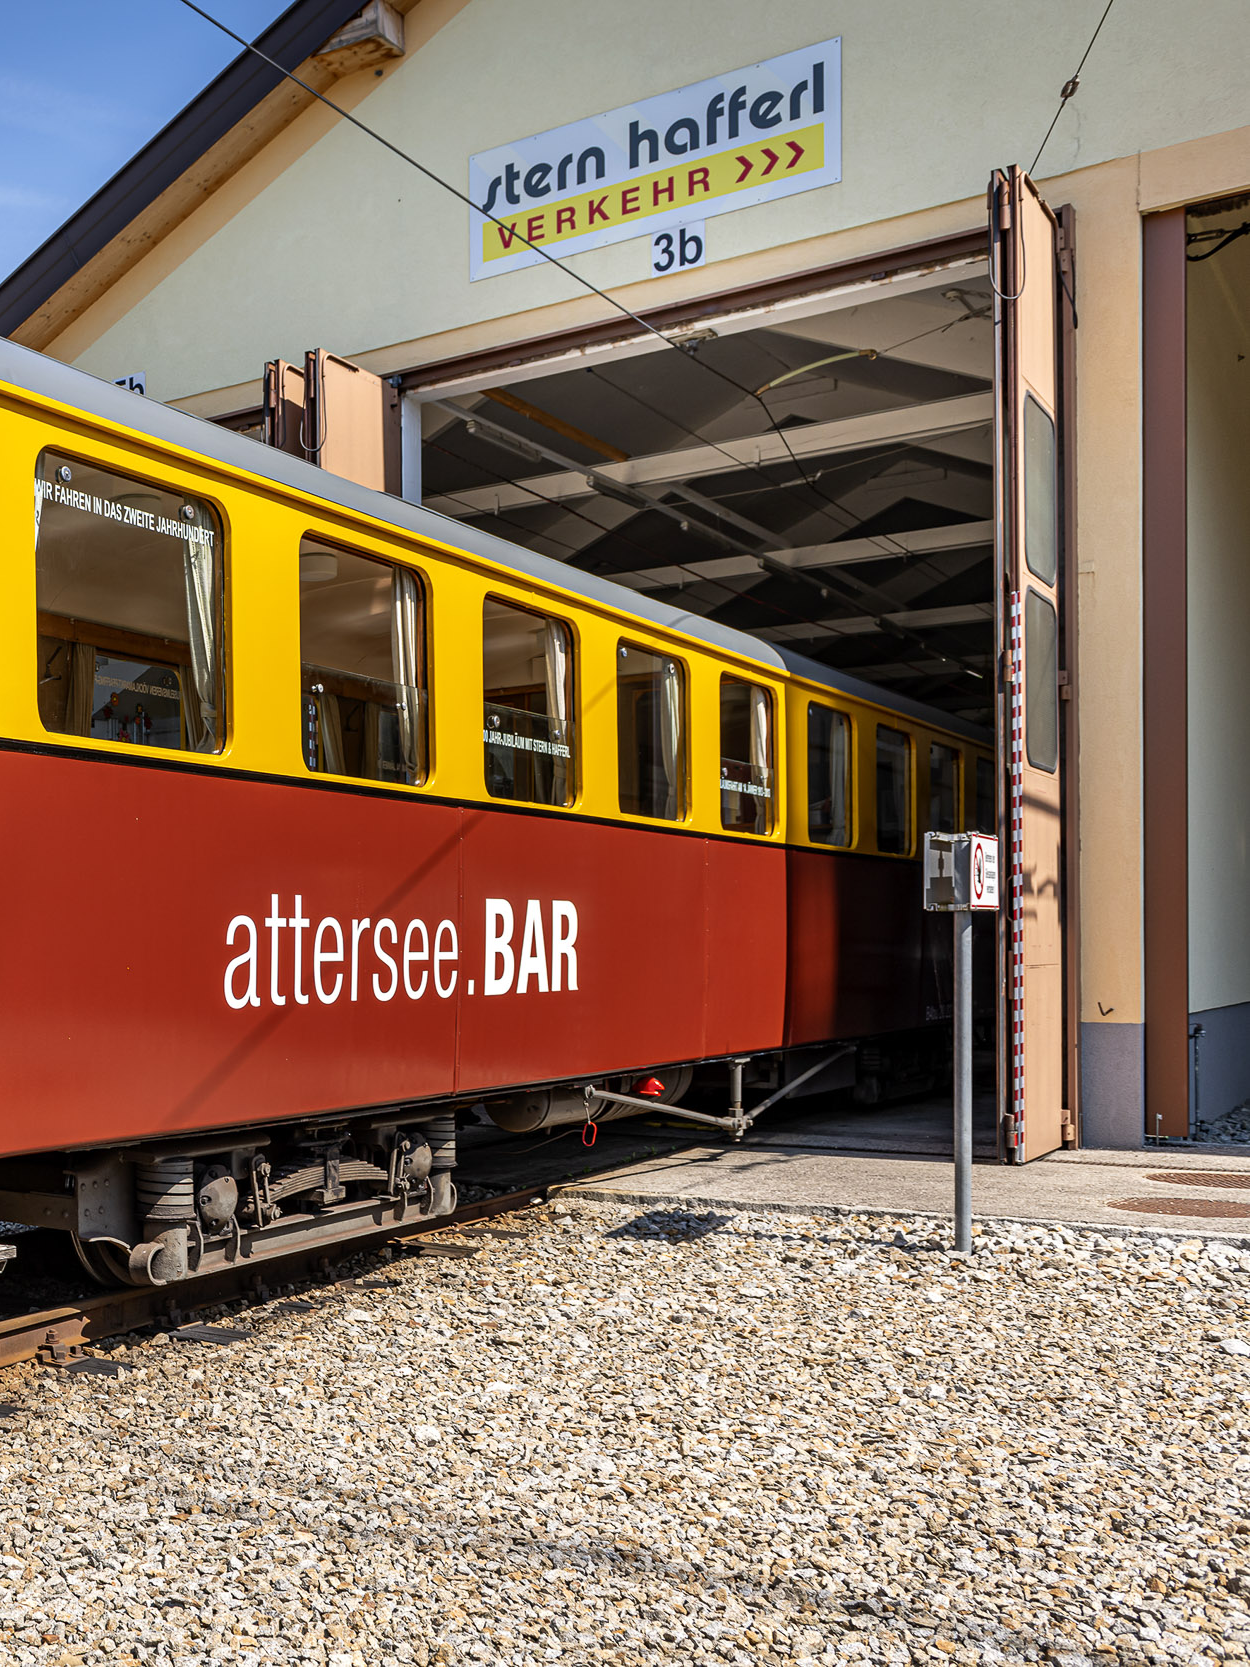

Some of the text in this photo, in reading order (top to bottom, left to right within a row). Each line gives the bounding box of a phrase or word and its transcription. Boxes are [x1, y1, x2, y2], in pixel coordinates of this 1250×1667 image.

[482, 61, 824, 213] stern hafferl
[497, 167, 710, 250] VERKEHR
[653, 228, 703, 272] 3b
[35, 478, 214, 547] WIR FAHREN IN DAS ZWEITE JAHRHUNDERT
[533, 739, 547, 753] STERN
[552, 742, 571, 759] HAFFERL
[224, 893, 579, 1010] attersee.BAR
